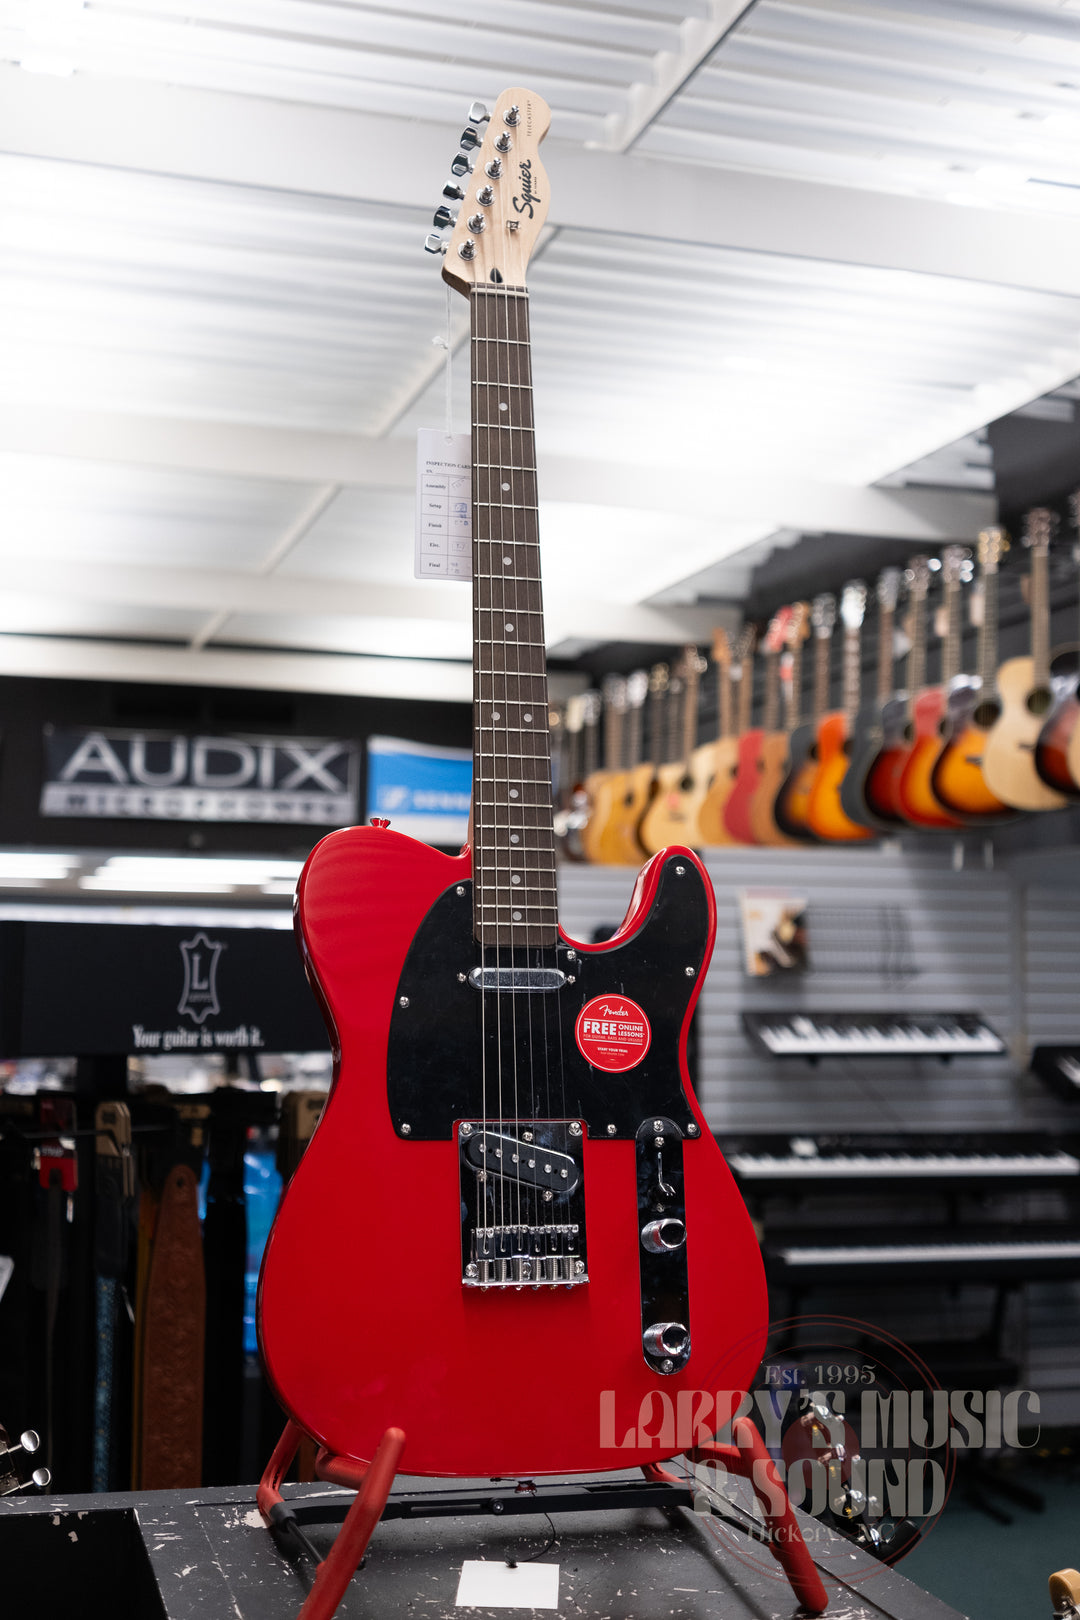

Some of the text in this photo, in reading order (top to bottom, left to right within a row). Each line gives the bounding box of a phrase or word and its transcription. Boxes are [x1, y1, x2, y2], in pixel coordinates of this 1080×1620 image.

[512, 159, 541, 219] Squier
[58, 733, 346, 792] AUDIX
[598, 1004, 629, 1017] Fender
[132, 1024, 161, 1048] Your
[162, 1025, 199, 1051] guitar
[201, 1025, 213, 1047] is
[214, 1024, 248, 1047] worth
[583, 1020, 644, 1036] FREE ONLINE
